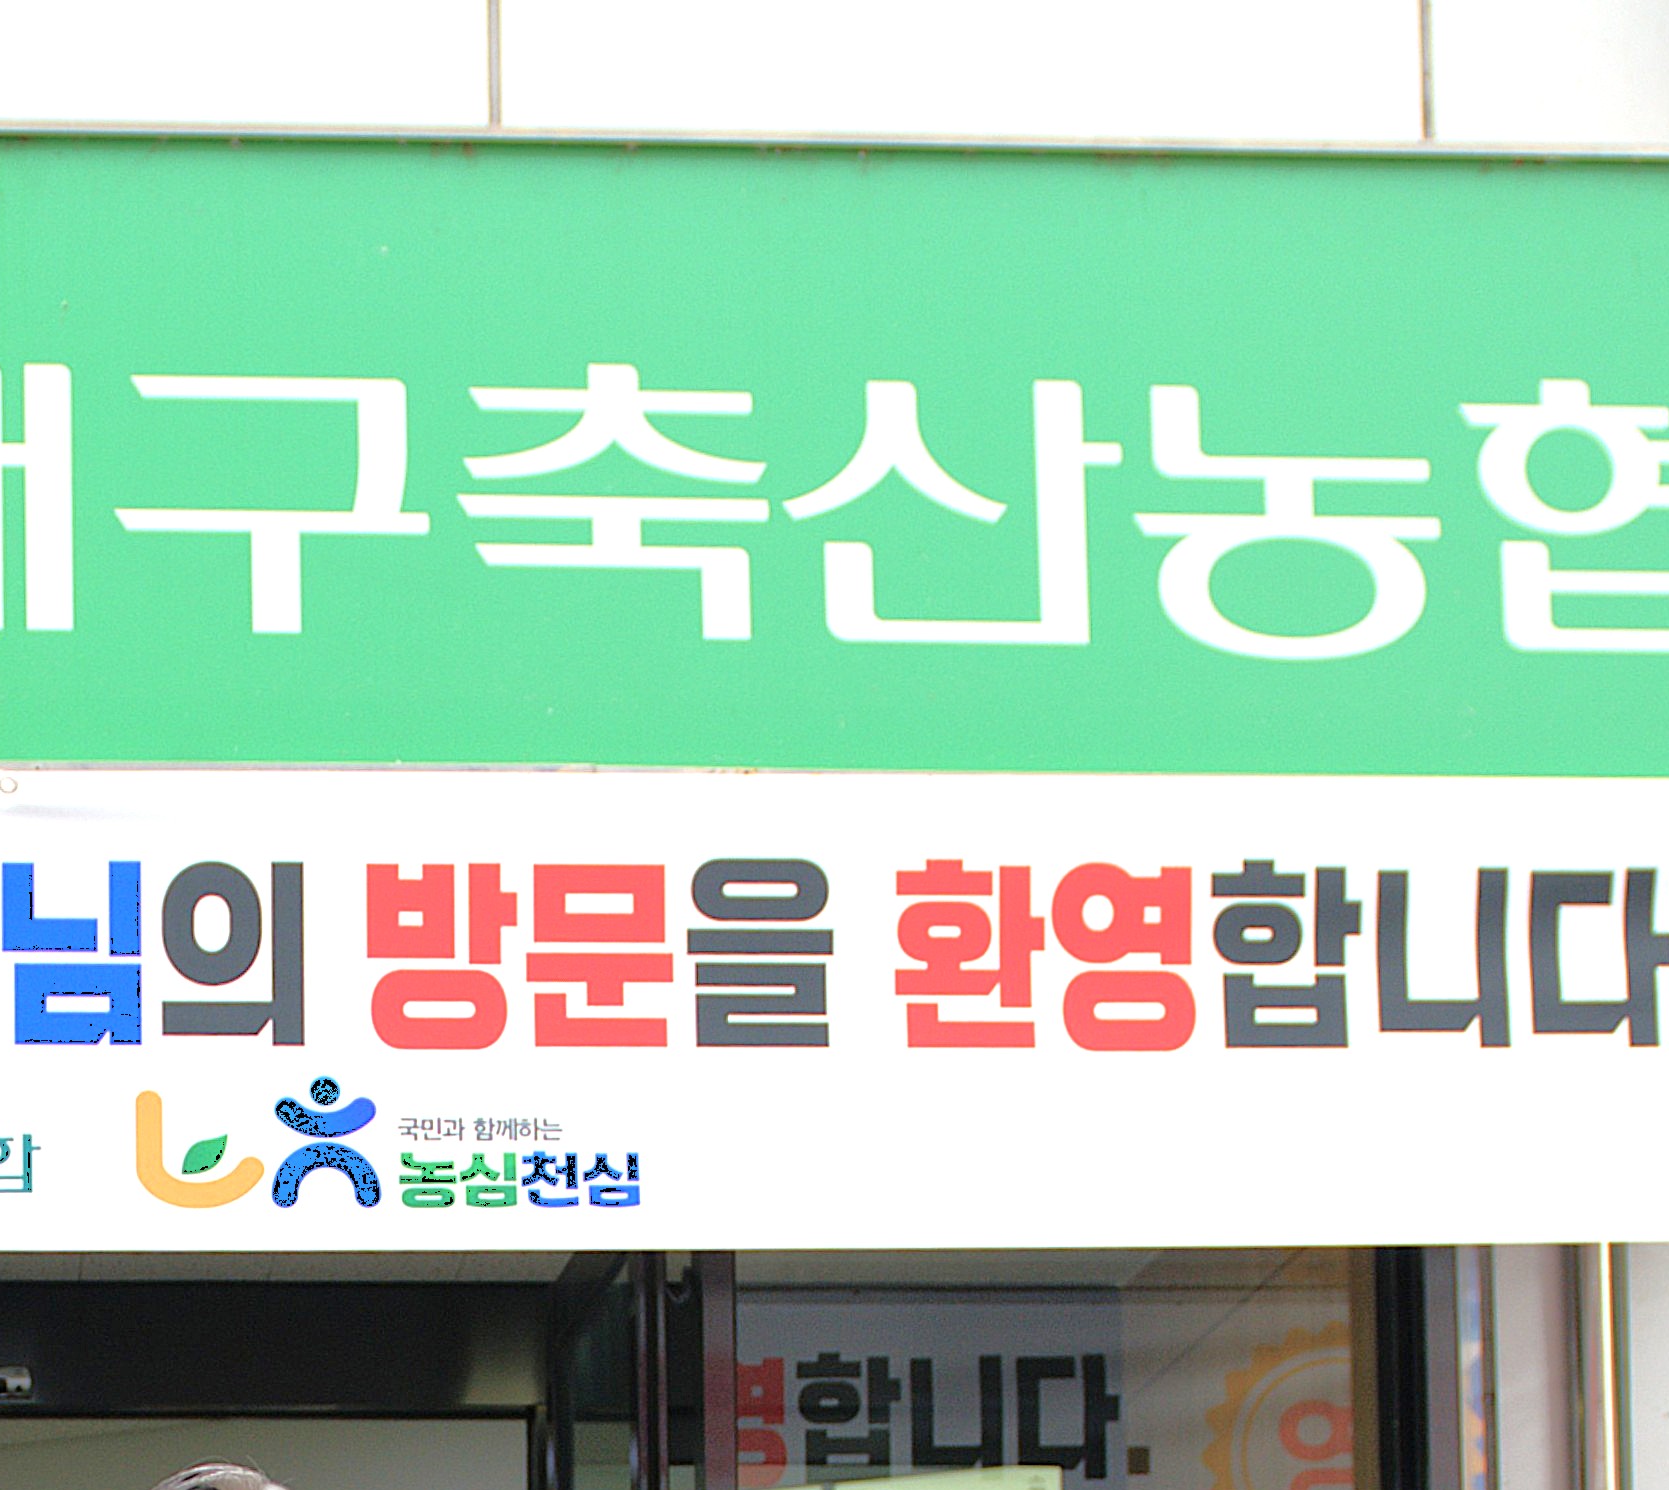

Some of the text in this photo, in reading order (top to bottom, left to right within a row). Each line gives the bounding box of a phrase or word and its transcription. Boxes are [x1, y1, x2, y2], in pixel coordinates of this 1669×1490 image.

[365, 856, 835, 1052] 방문을
[397, 1116, 564, 1142] 국민과 함께하는
[398, 1150, 642, 1209] 농심천심
